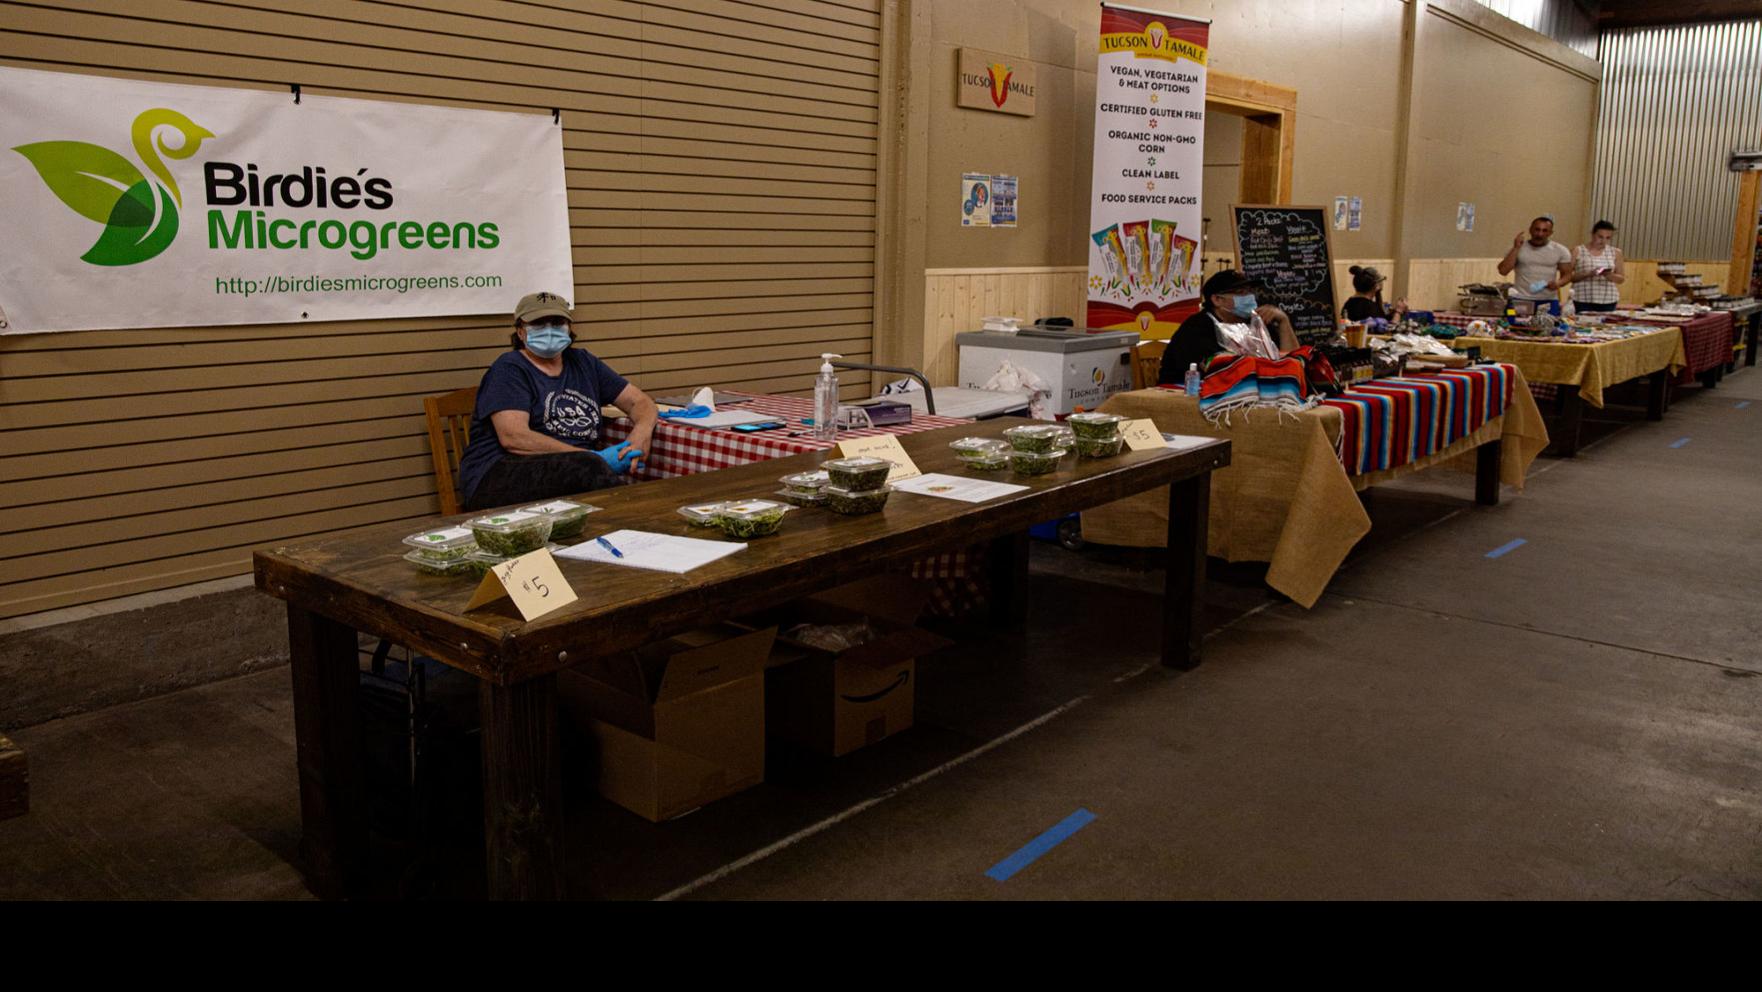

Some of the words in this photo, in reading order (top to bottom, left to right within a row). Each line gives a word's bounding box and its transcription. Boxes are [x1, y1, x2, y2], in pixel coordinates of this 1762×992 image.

[1104, 36, 1148, 49] TUCSON
[1164, 39, 1205, 61] TAMALE
[1110, 65, 1142, 78] VEGAN,
[1144, 69, 1199, 83] VEGETARIAN
[1127, 81, 1149, 91] MEAT
[1150, 82, 1190, 94] OPTIONS
[1100, 103, 1147, 116] CERTIFIED
[1149, 107, 1182, 119] GLUTEN
[1184, 110, 1203, 120] FREE
[1108, 129, 1151, 141] ORGANIC
[1153, 133, 1196, 145] NON-GMO
[1138, 143, 1166, 153] CORN
[1122, 168, 1152, 179] CLEAN
[1153, 169, 1180, 180] LABEL
[1101, 193, 1127, 203] FOOD
[1128, 194, 1167, 204] SERVICE
[1168, 195, 1197, 205] PACKS
[206, 210, 500, 260] Microgreens
[215, 272, 503, 297] http://birdiesmicrogreens.com
